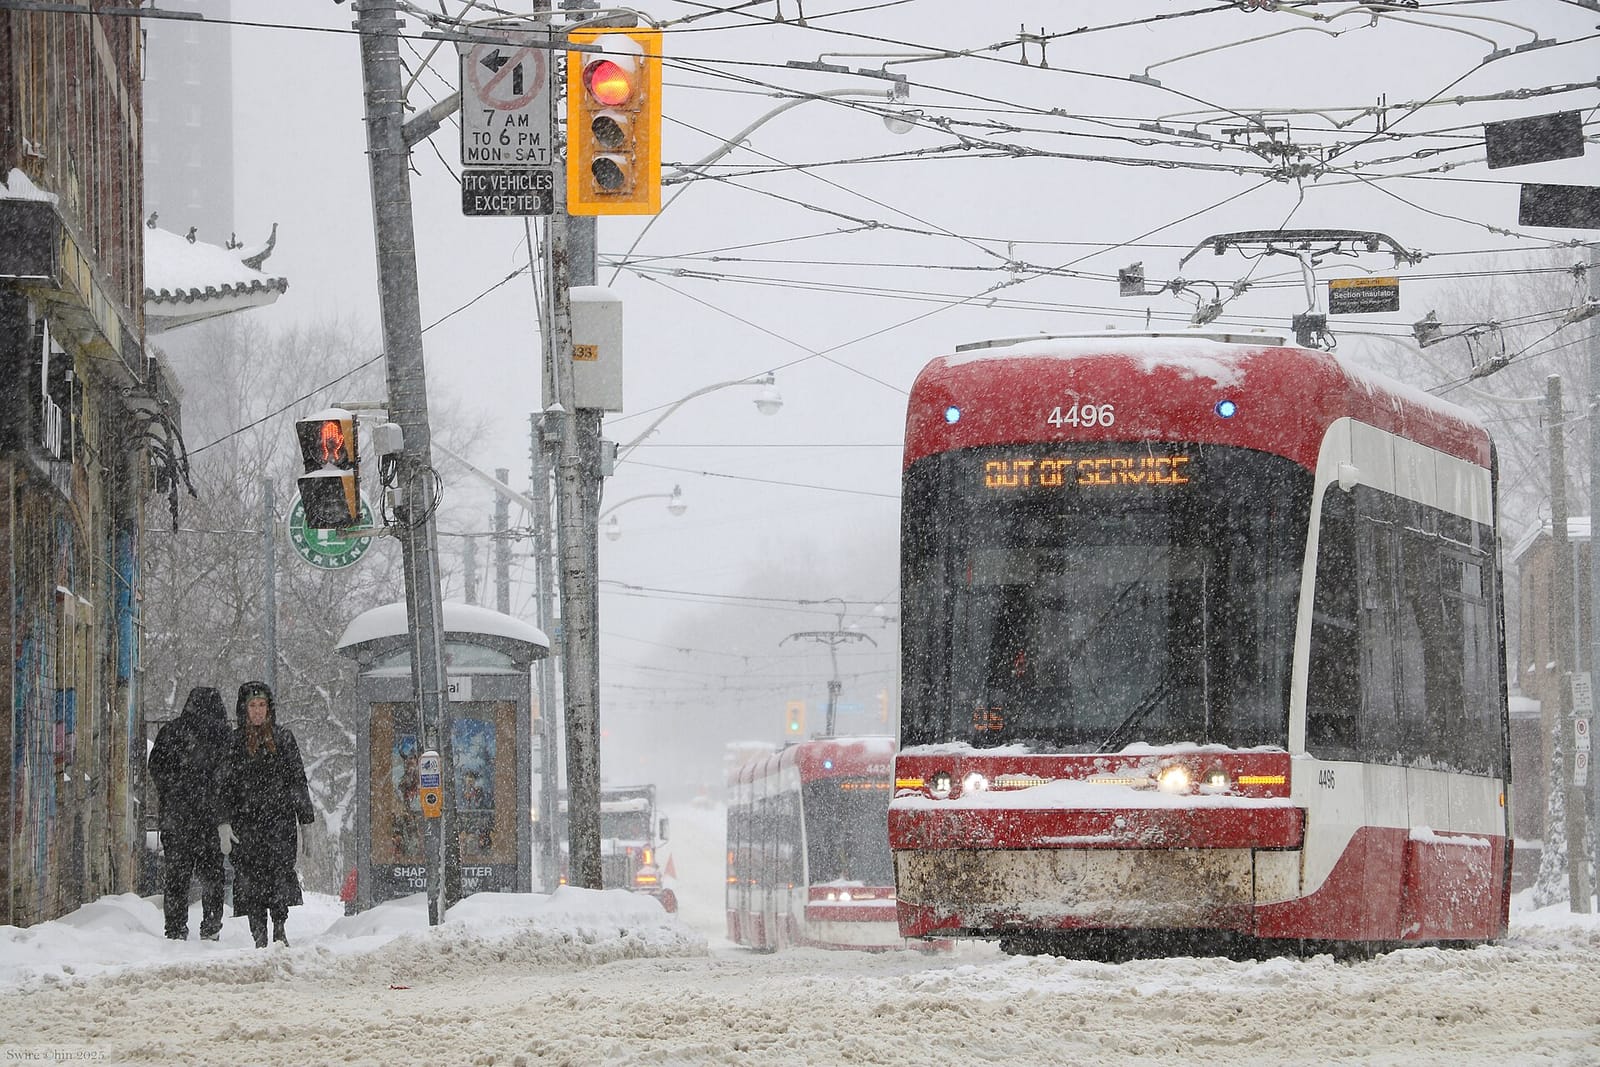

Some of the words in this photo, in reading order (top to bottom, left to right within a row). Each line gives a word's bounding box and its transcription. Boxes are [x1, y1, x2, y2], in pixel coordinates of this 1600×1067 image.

[483, 109, 496, 127] 7
[504, 113, 529, 127] AM
[472, 131, 492, 146] TO
[499, 128, 511, 146] 6
[518, 132, 541, 146] PM
[468, 147, 502, 161] MON
[515, 148, 547, 161] SAT
[463, 175, 486, 190] TTC
[491, 175, 553, 190] VEHICLES
[475, 196, 541, 210] EXCEPTED
[1333, 290, 1361, 299] Section
[1362, 290, 1395, 298] Insulator
[1047, 404, 1115, 428] 4496
[984, 460, 1034, 487] OUT
[1040, 459, 1073, 486] OF
[1078, 456, 1190, 485] SERVICE
[293, 535, 369, 566] PARKING
[1318, 769, 1336, 789] 4496
[394, 867, 426, 877] SHAP
